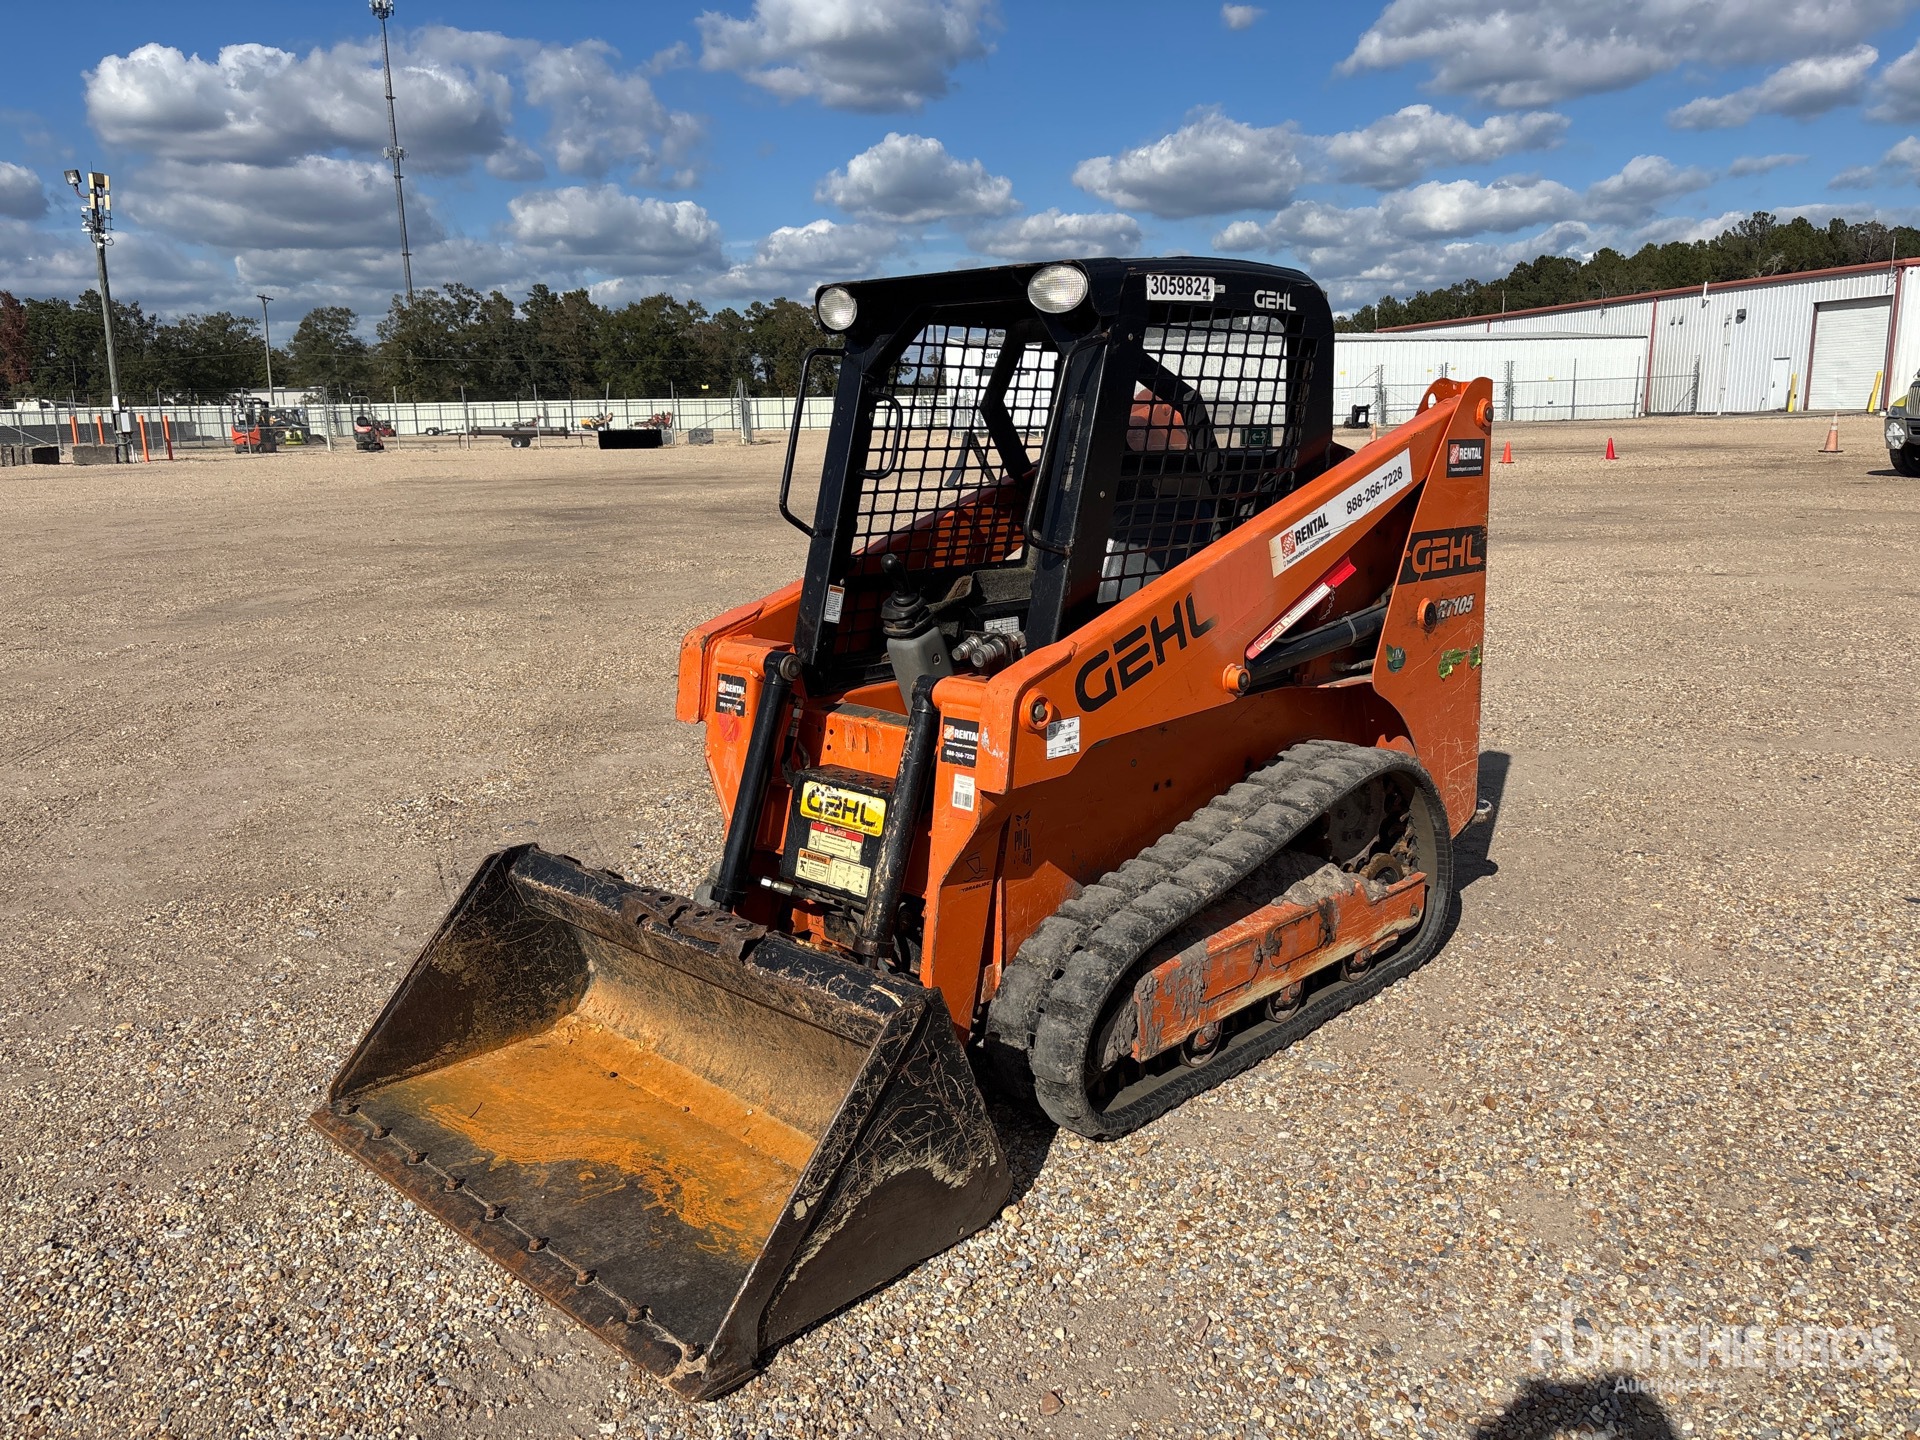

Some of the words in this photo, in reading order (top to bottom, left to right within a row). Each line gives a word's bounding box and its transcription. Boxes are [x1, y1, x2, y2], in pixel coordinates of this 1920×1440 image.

[1151, 275, 1210, 296] 3059824
[1254, 290, 1297, 312] GEHL
[1459, 446, 1482, 460] RENTAL
[1294, 513, 1329, 546] RENTAL
[1346, 466, 1403, 515] 888-266-7228
[1411, 532, 1482, 574] GEHL
[1074, 592, 1220, 713] GEHL
[806, 785, 878, 829] GEHL
